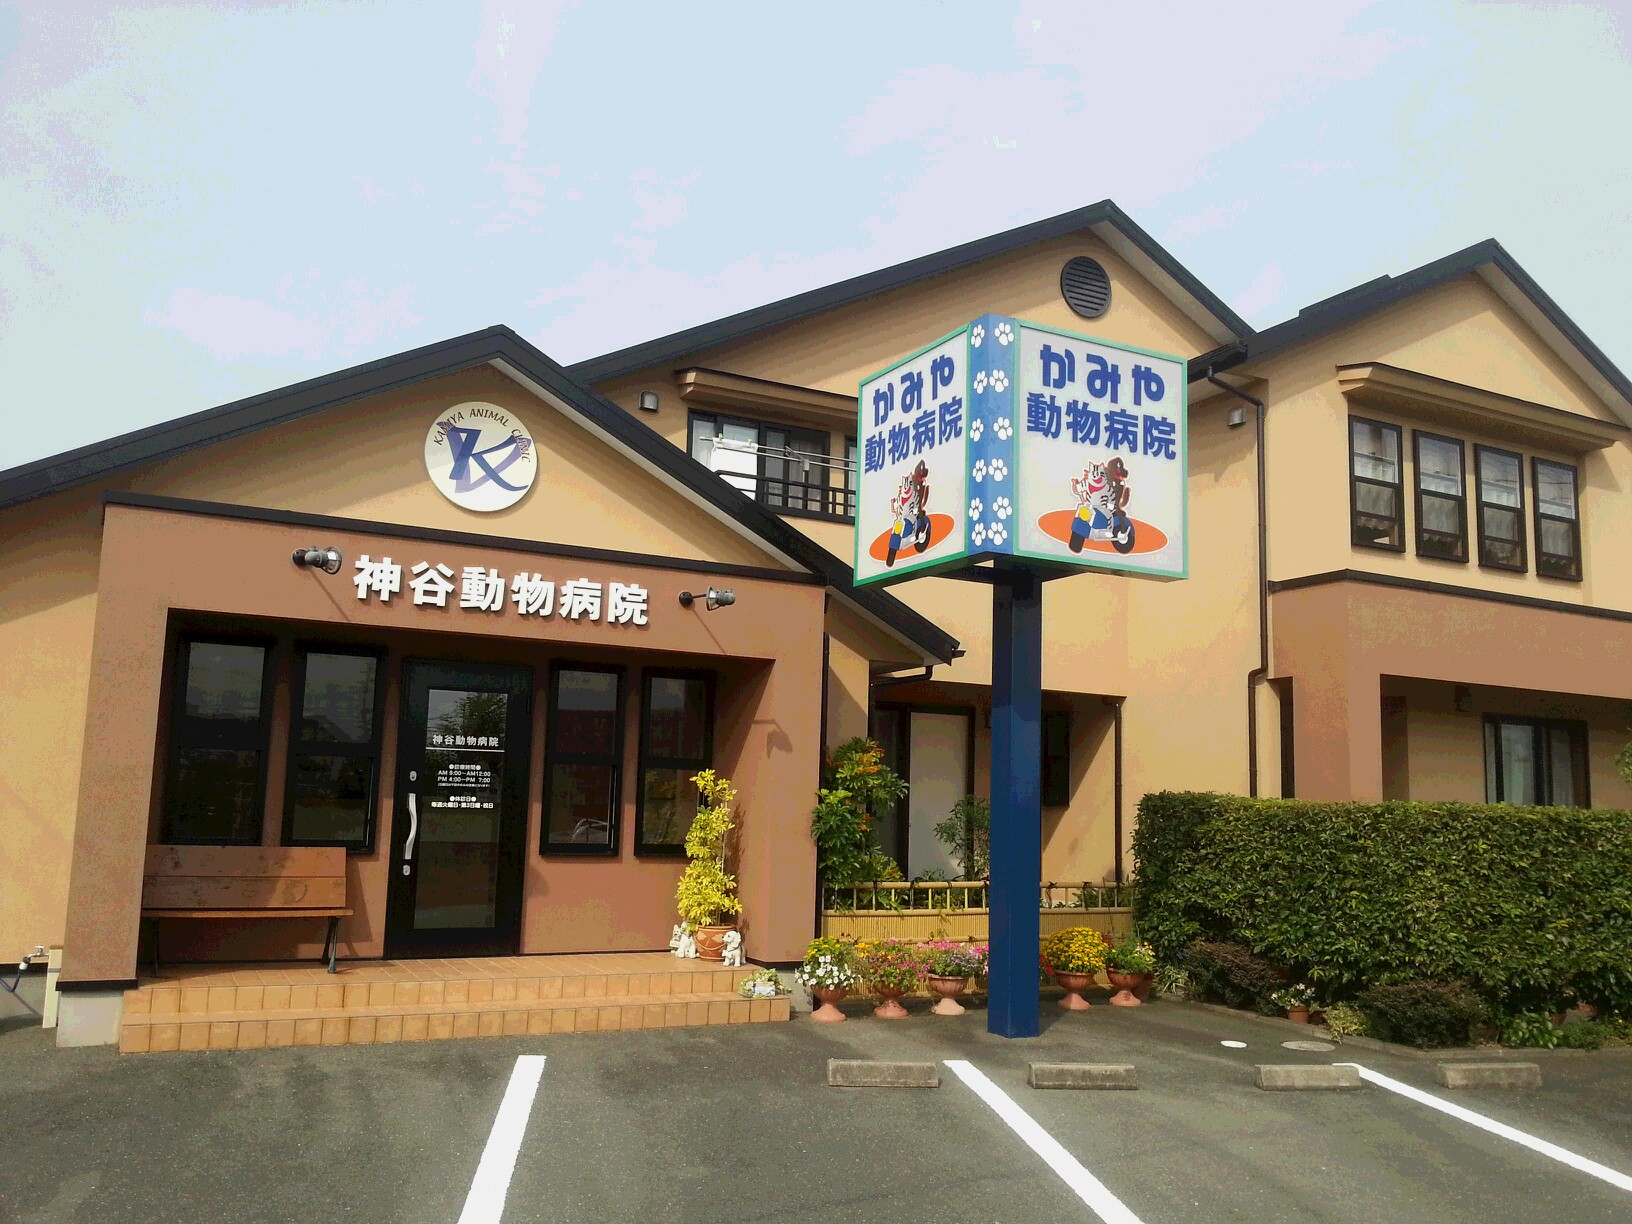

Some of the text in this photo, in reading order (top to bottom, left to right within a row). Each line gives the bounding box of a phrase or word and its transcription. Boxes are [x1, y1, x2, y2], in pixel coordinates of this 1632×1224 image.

[873, 354, 955, 427] かみや
[1040, 343, 1165, 406] かみや
[433, 408, 531, 463] KAMIYA ANIMAL CLINIC
[864, 395, 963, 474] 動物病院
[1026, 391, 1177, 461] 動物病院
[353, 554, 649, 626] 神谷動物病院
[432, 734, 499, 747] 神谷動物病院
